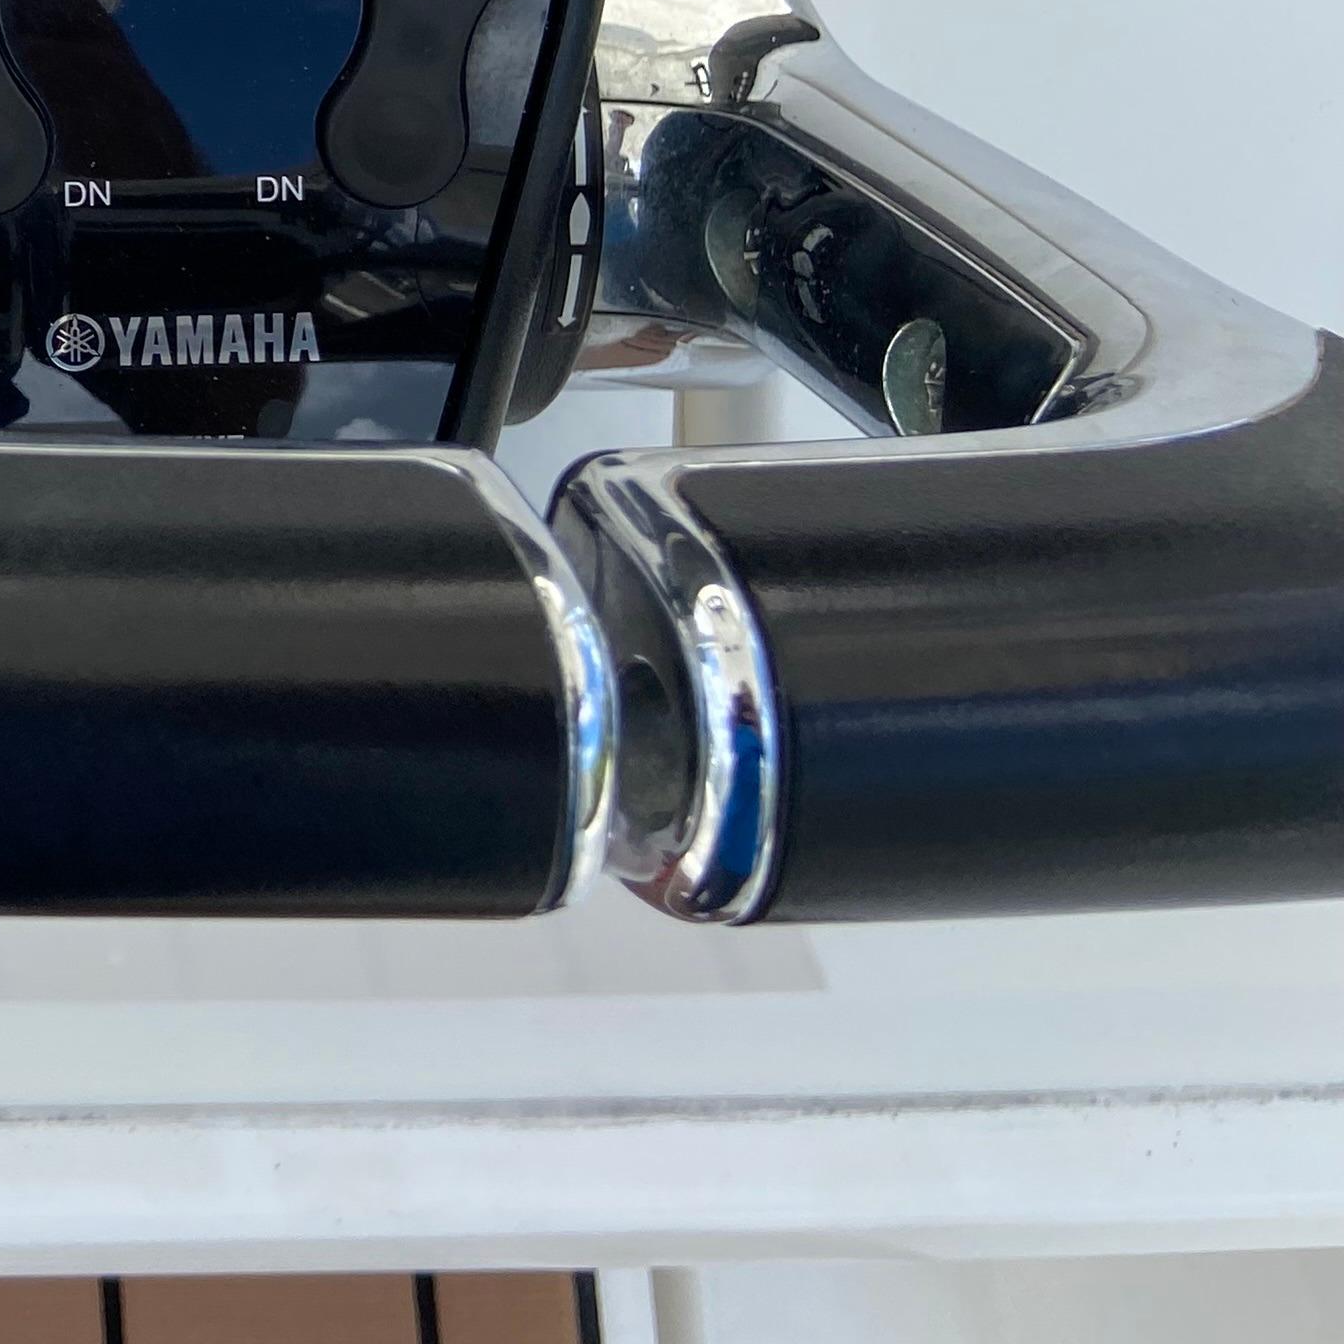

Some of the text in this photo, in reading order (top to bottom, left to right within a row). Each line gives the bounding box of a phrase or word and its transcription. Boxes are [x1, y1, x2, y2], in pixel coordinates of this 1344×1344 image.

[63, 181, 111, 208] DN
[256, 175, 304, 203] DN
[109, 313, 320, 367] YAMAHA
